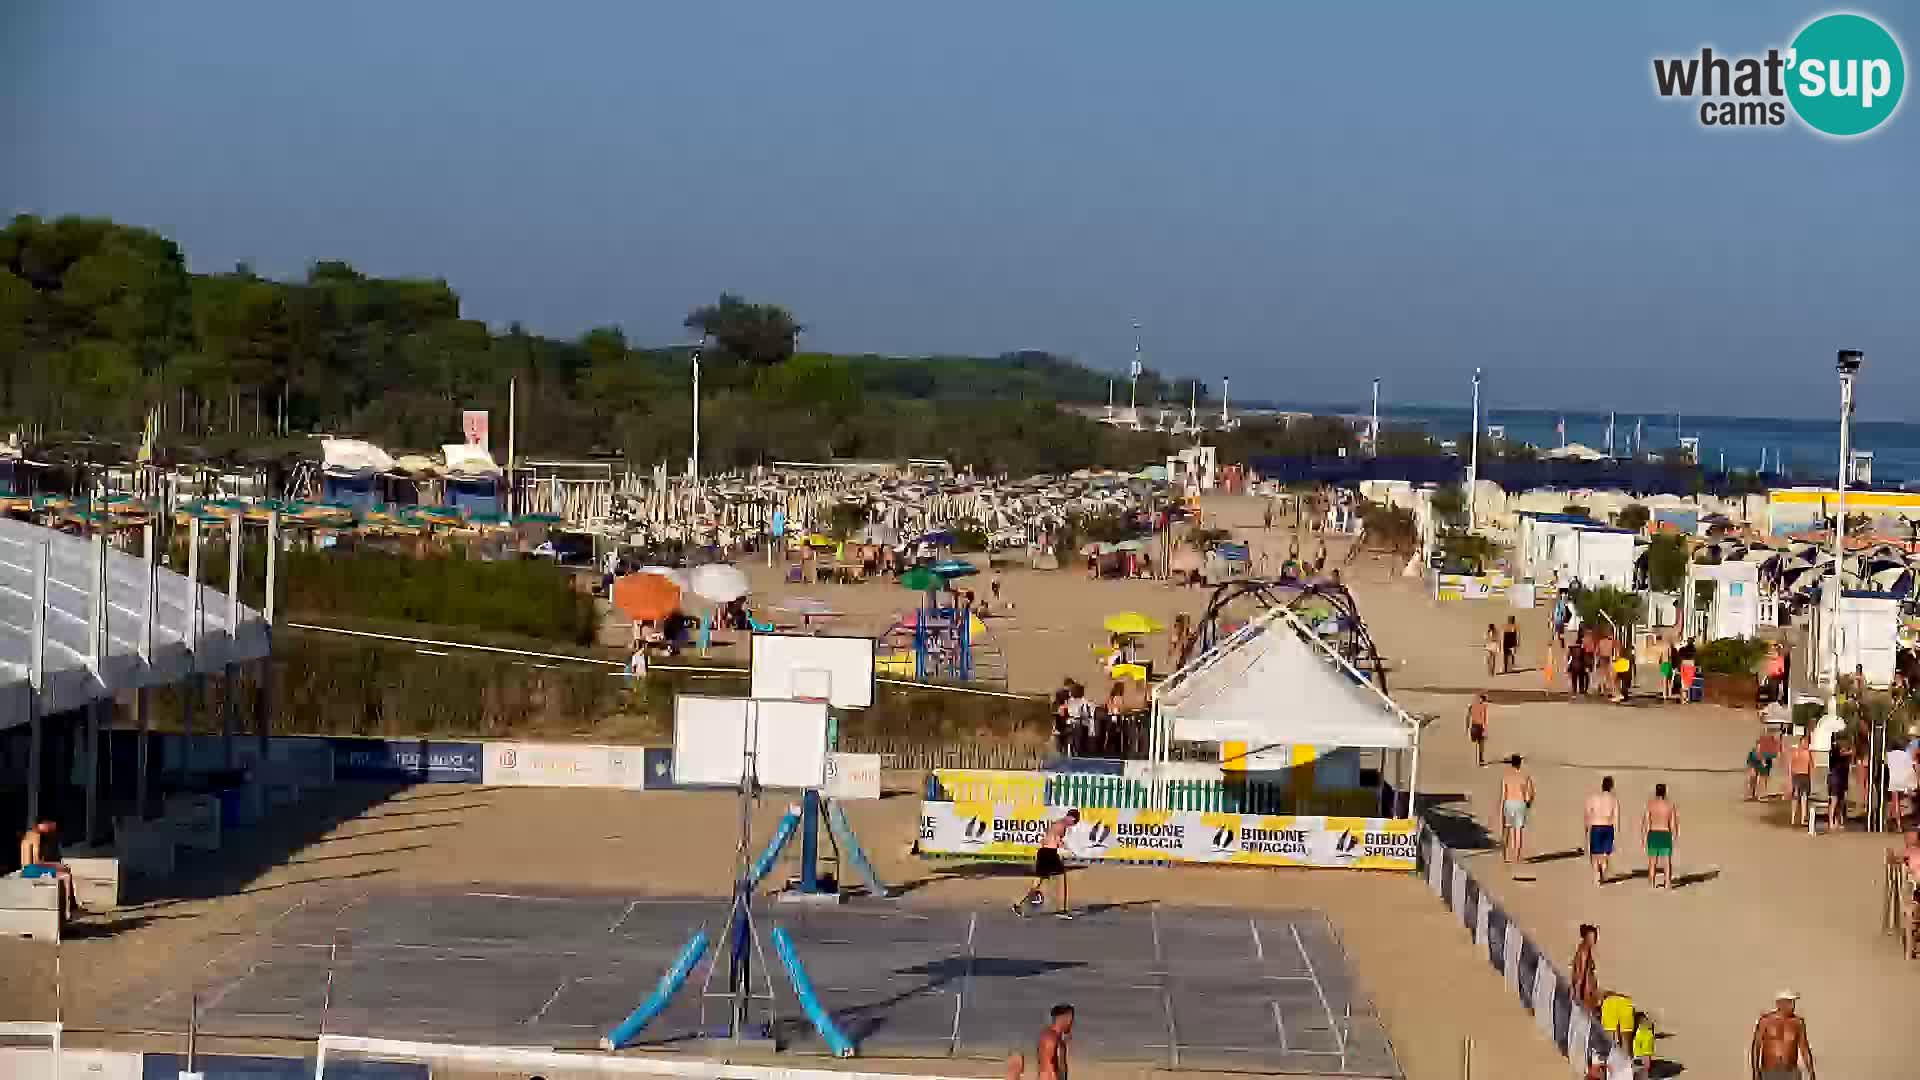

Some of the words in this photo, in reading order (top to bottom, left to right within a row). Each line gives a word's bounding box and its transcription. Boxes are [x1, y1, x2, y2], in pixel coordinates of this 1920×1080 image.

[993, 819, 1049, 832] BIBION
[1117, 823, 1184, 837] BIBIONE
[1241, 828, 1309, 842] BIBIONE
[1365, 832, 1417, 846] BIBION
[1117, 837, 1183, 848] SPIAGGIA
[1364, 846, 1416, 857] SPIAGG
